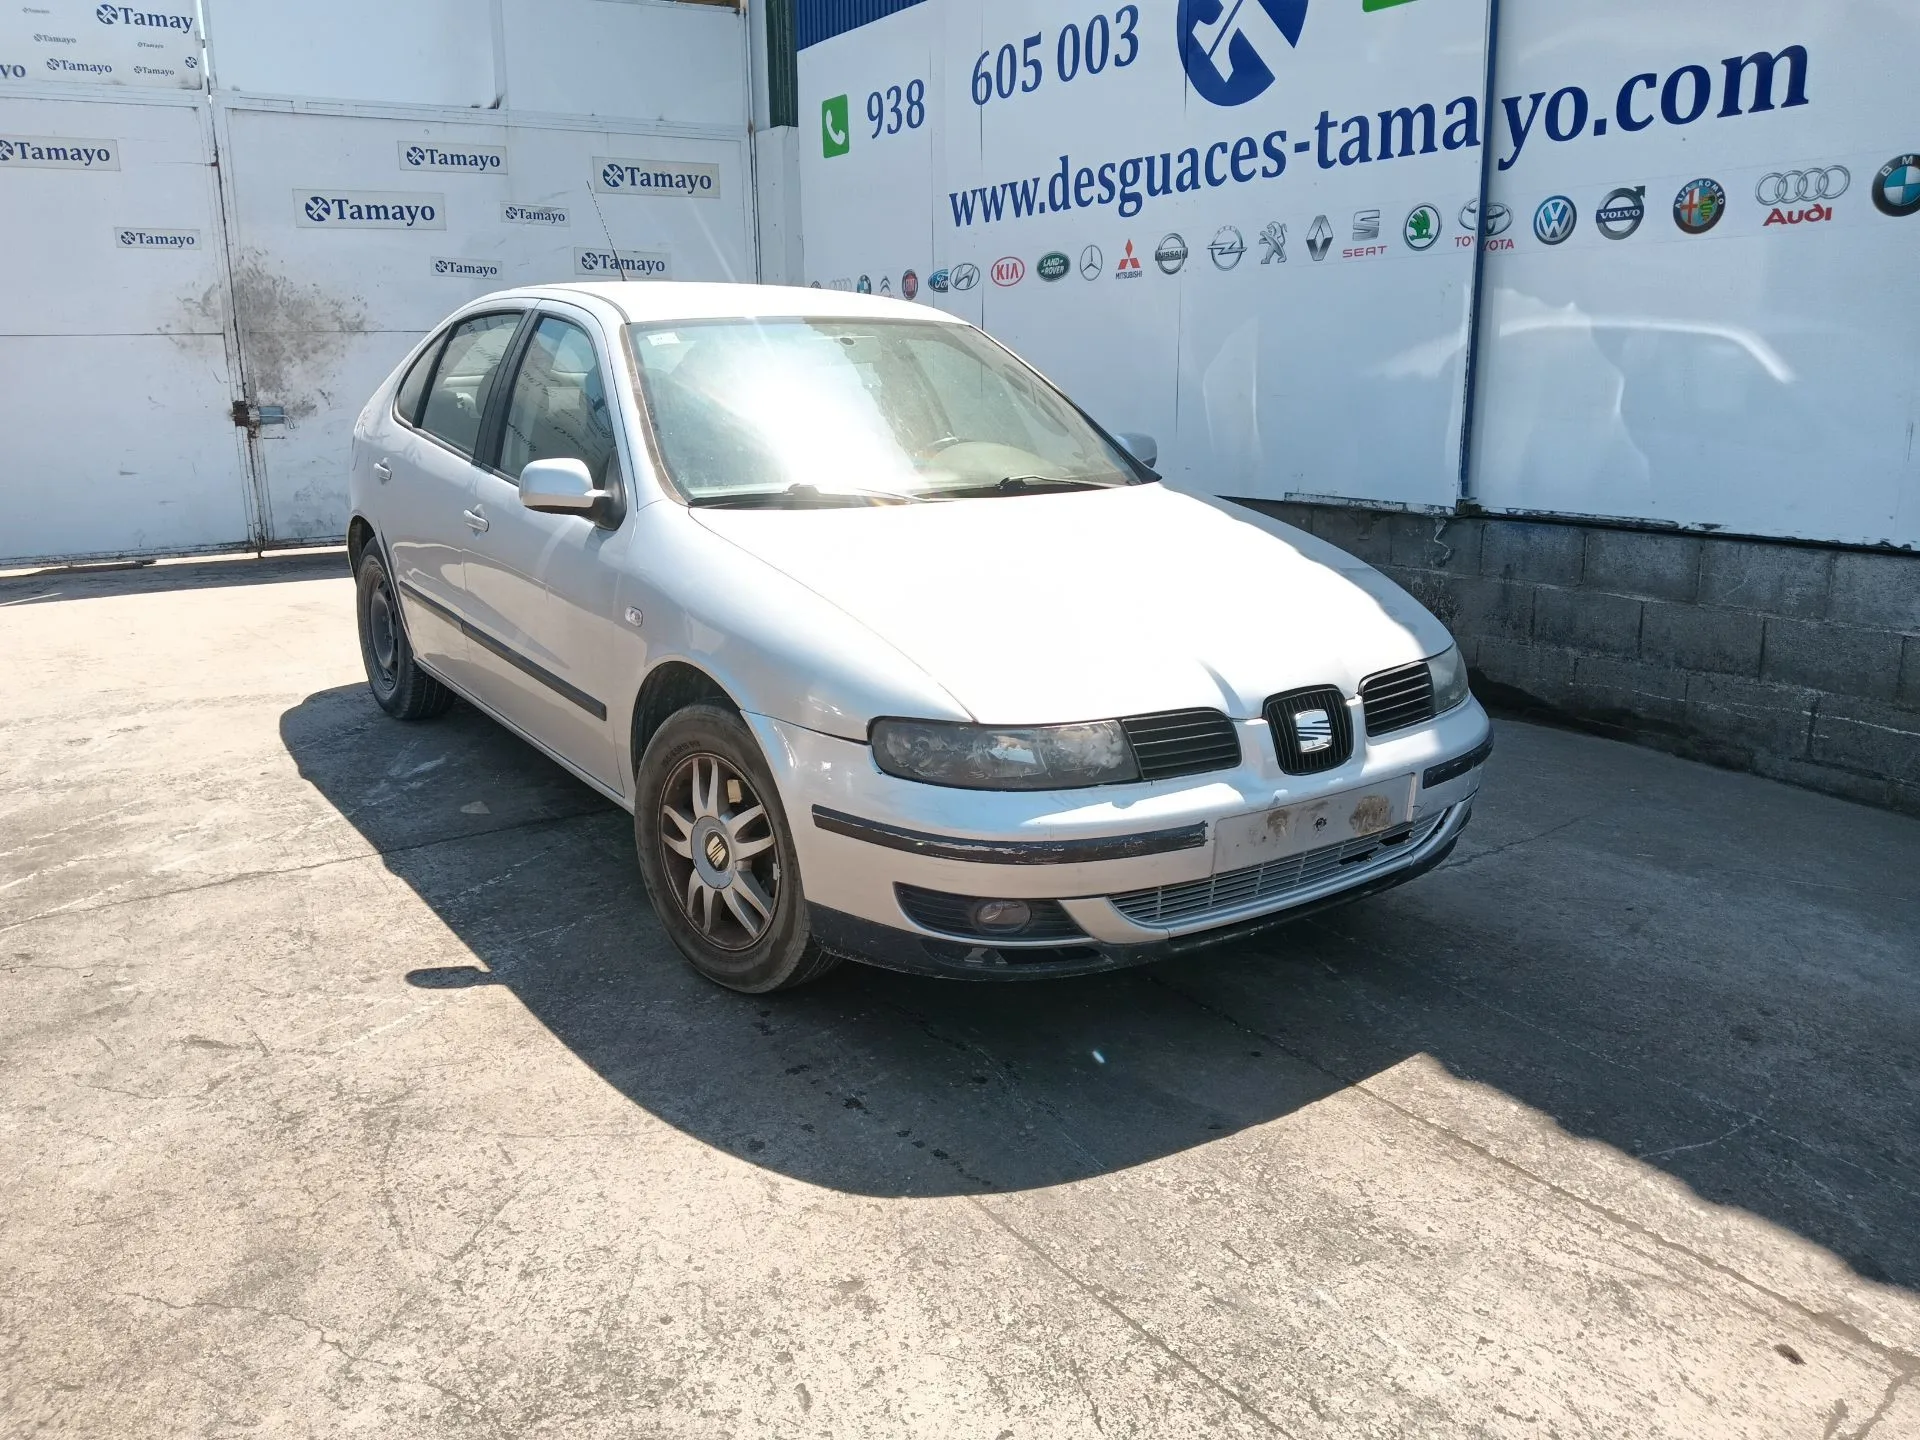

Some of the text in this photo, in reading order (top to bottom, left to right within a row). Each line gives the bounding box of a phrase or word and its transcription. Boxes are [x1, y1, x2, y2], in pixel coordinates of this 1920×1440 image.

[118, 7, 194, 34] Tamay
[59, 60, 113, 76] Tamayo
[142, 66, 175, 76] Tamayo
[866, 4, 1139, 140] 938 605 003
[949, 44, 1810, 227] www.desguaces-tamayo.com
[14, 141, 110, 166] Tamayo
[425, 148, 501, 171] Tamayo
[625, 166, 712, 195] Tamayo
[332, 198, 435, 227] Tamayo
[517, 208, 566, 224] Tamayo
[1600, 208, 1641, 220] VOLVO
[1762, 203, 1832, 226] Audi
[135, 232, 195, 248] Tamayo
[1342, 246, 1387, 258] SEAT
[448, 261, 498, 278] Tamayo
[599, 254, 666, 276] Tamayo
[1043, 257, 1060, 267] LAND
[1044, 265, 1065, 275] ROVER
[996, 264, 1019, 281] KIA
[1115, 270, 1143, 280] MITSUBISHI
